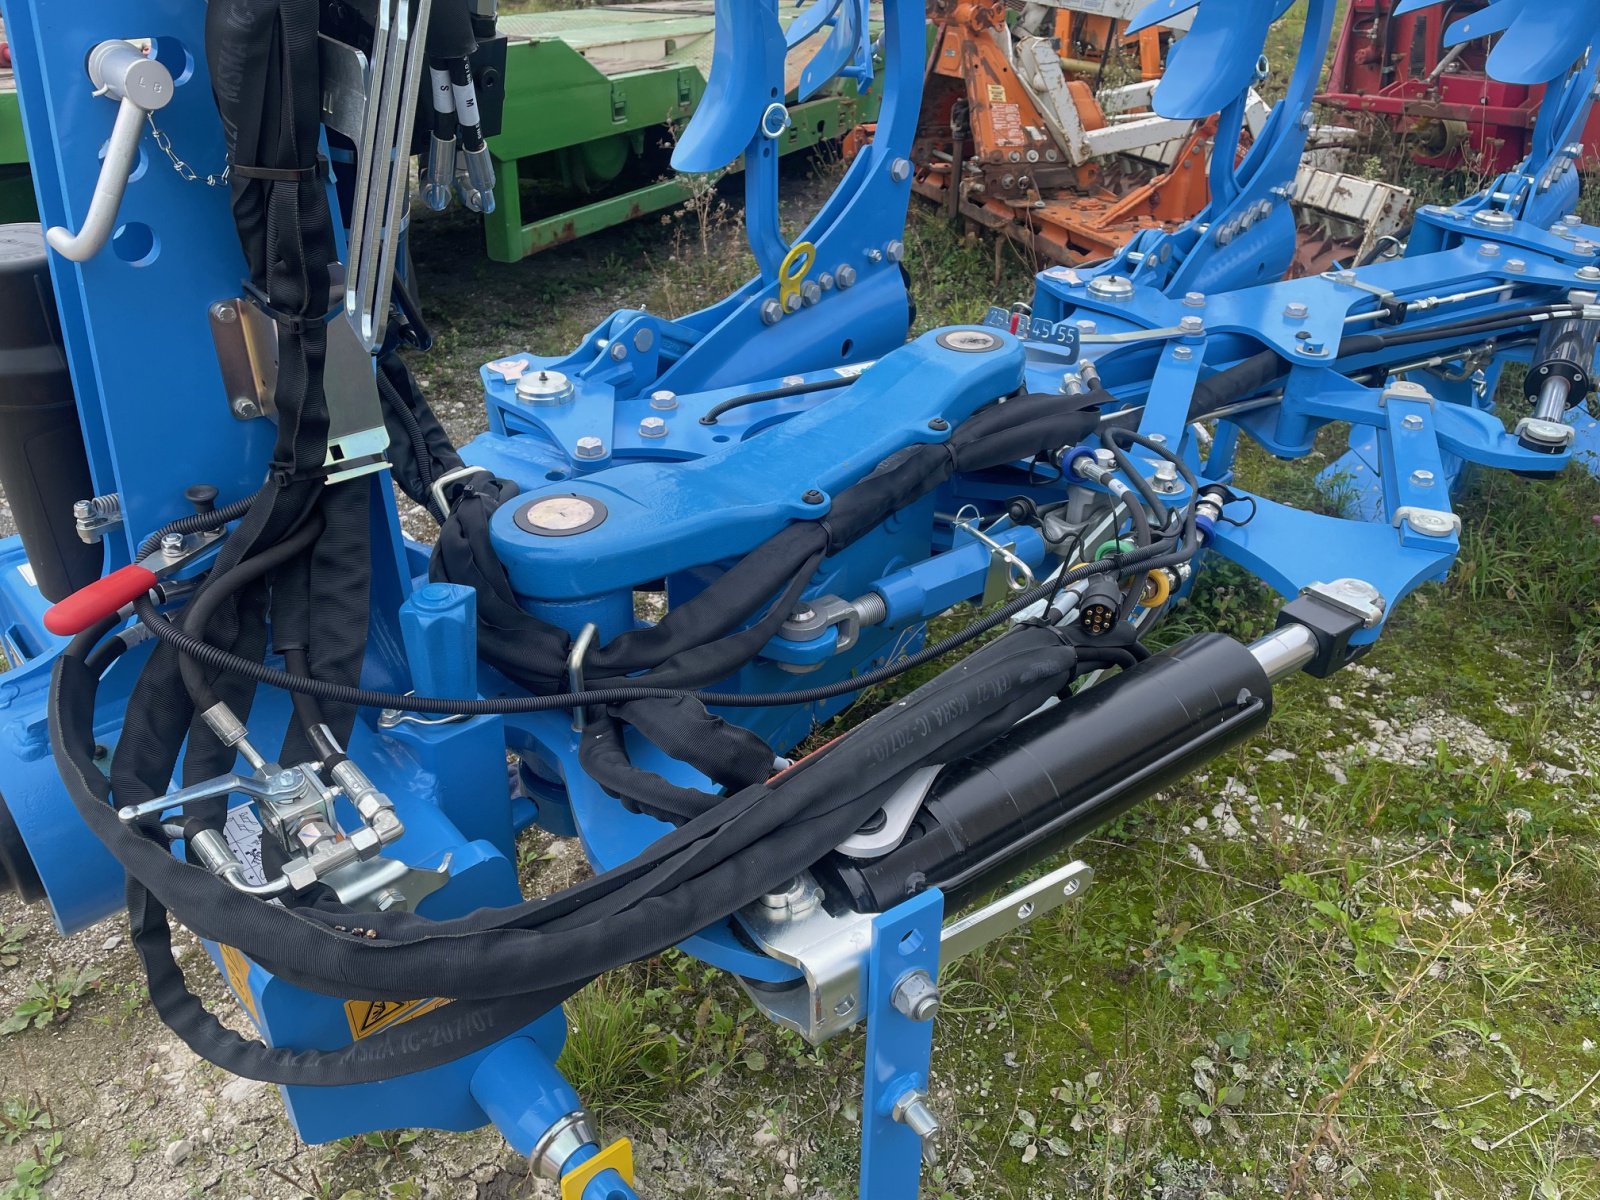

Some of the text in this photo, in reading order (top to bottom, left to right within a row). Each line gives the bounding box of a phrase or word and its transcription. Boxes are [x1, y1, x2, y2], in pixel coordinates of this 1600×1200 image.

[465, 98, 475, 108] M
[989, 310, 1005, 326] 25
[1032, 321, 1050, 338] 45
[1057, 326, 1075, 344] 55
